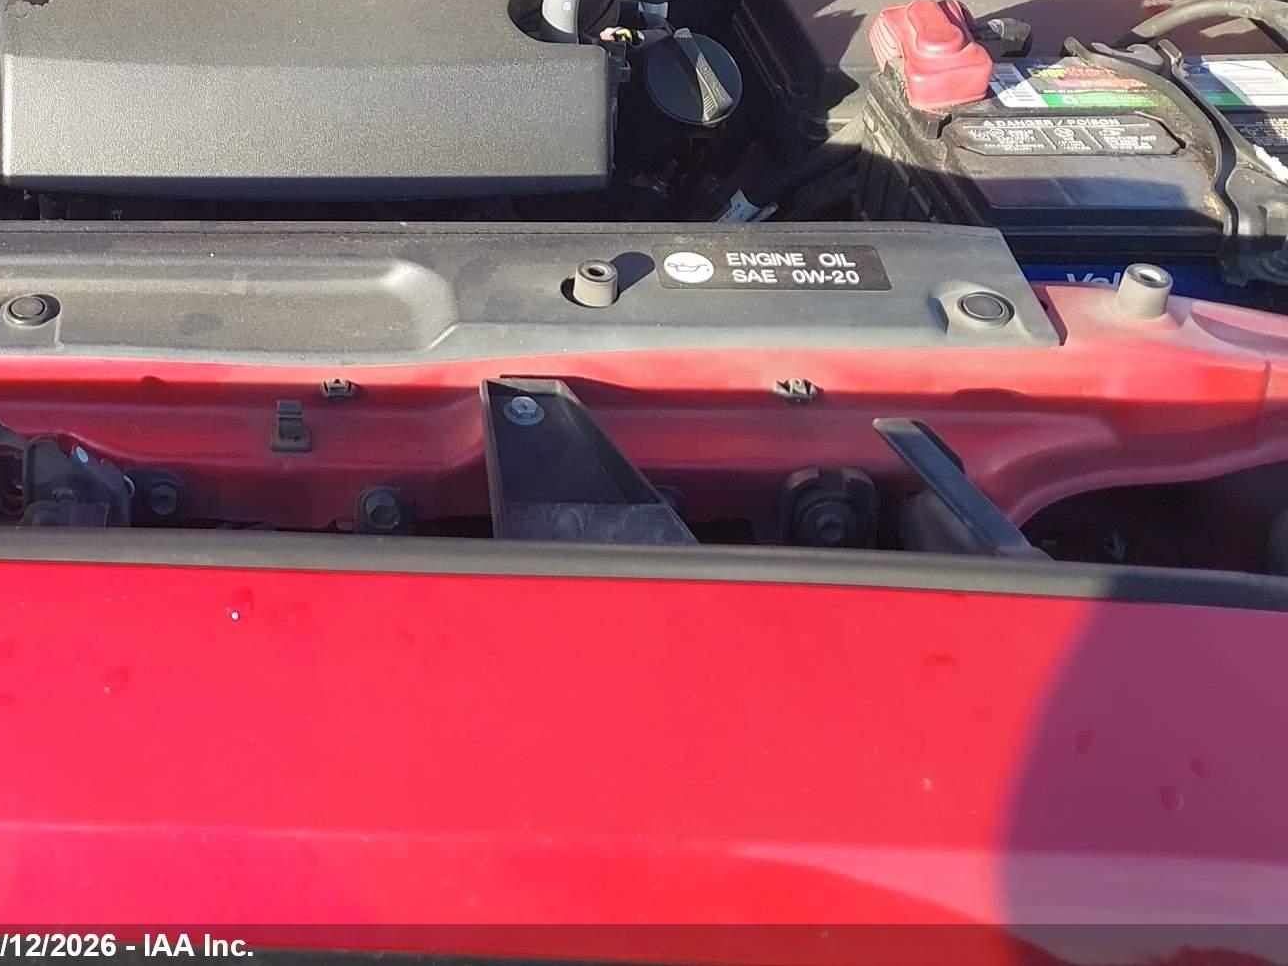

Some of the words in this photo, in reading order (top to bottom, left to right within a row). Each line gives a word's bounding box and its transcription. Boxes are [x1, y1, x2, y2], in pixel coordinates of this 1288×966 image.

[995, 119, 1055, 127] DANGER
[1067, 117, 1121, 126] POISON
[726, 252, 807, 267] ENGINE
[818, 253, 856, 267] OIL
[731, 269, 778, 283] SAE
[791, 269, 860, 284] 0W-20
